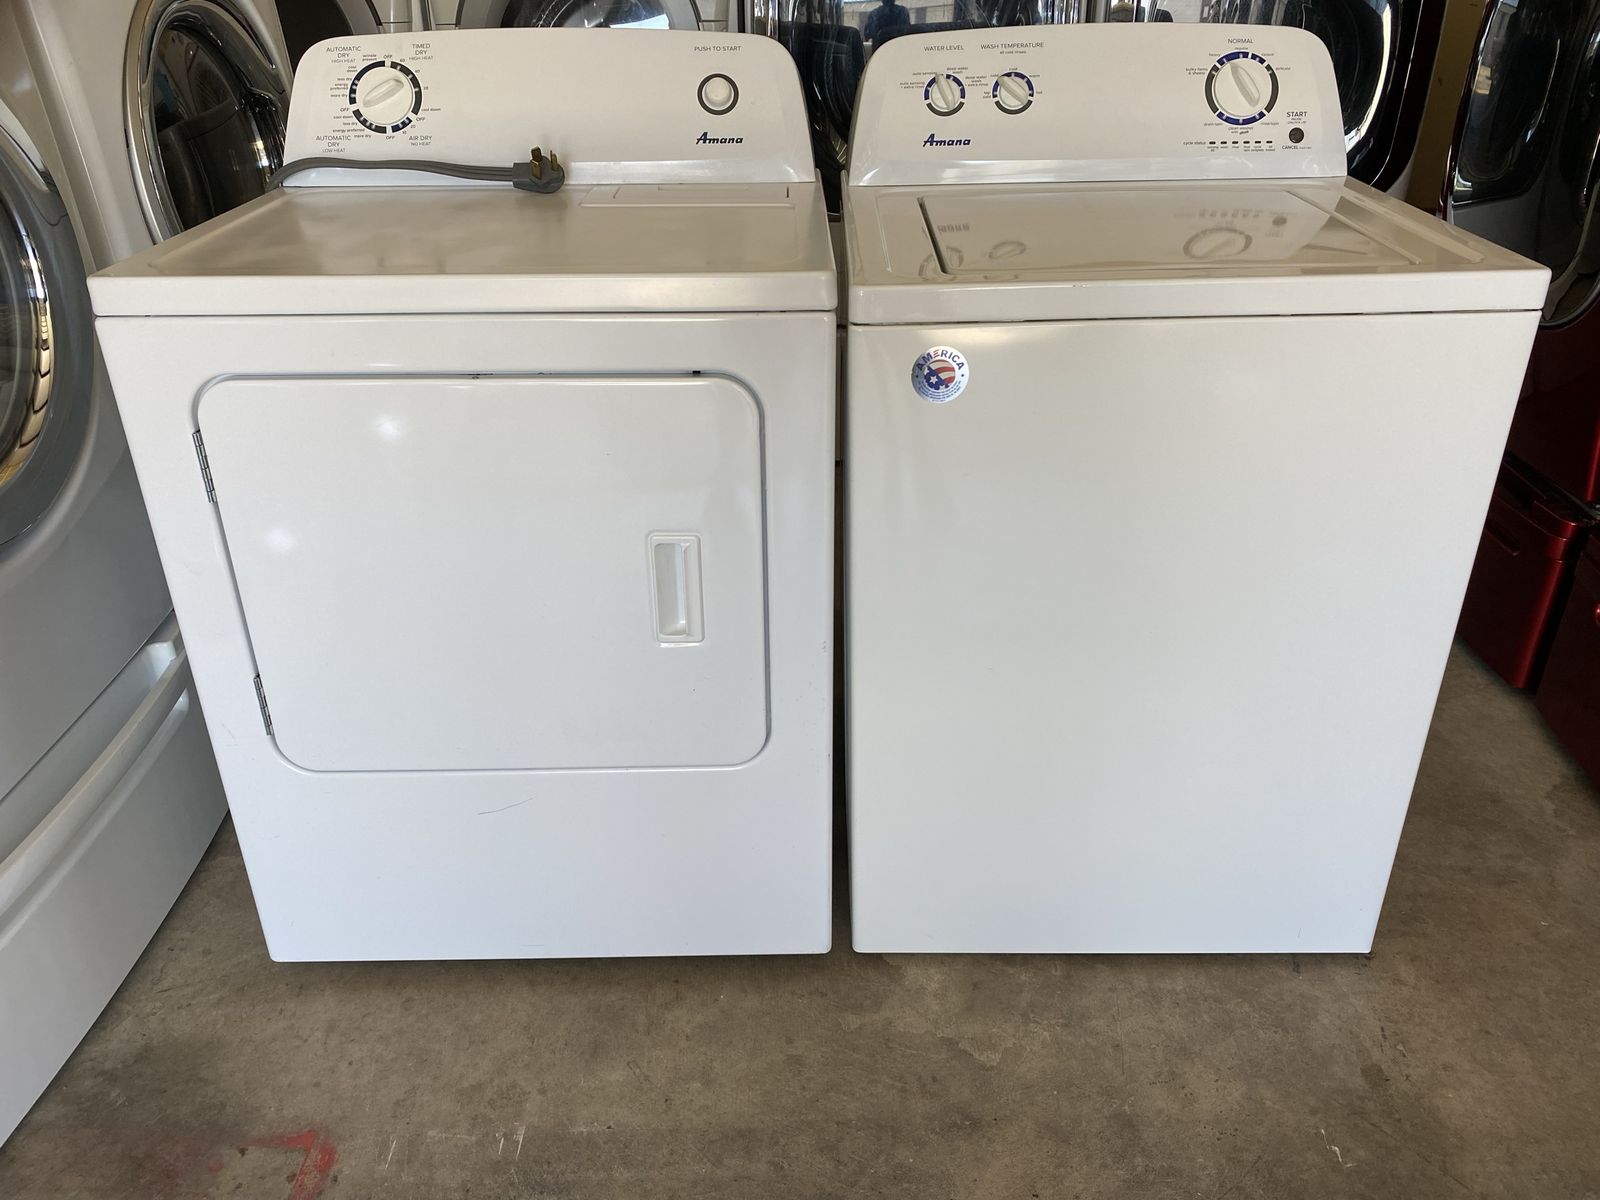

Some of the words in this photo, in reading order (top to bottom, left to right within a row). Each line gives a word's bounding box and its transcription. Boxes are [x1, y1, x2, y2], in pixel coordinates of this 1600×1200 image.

[695, 131, 744, 145] Amana
[922, 133, 972, 147] Amana
[916, 349, 965, 371] AMERICA
